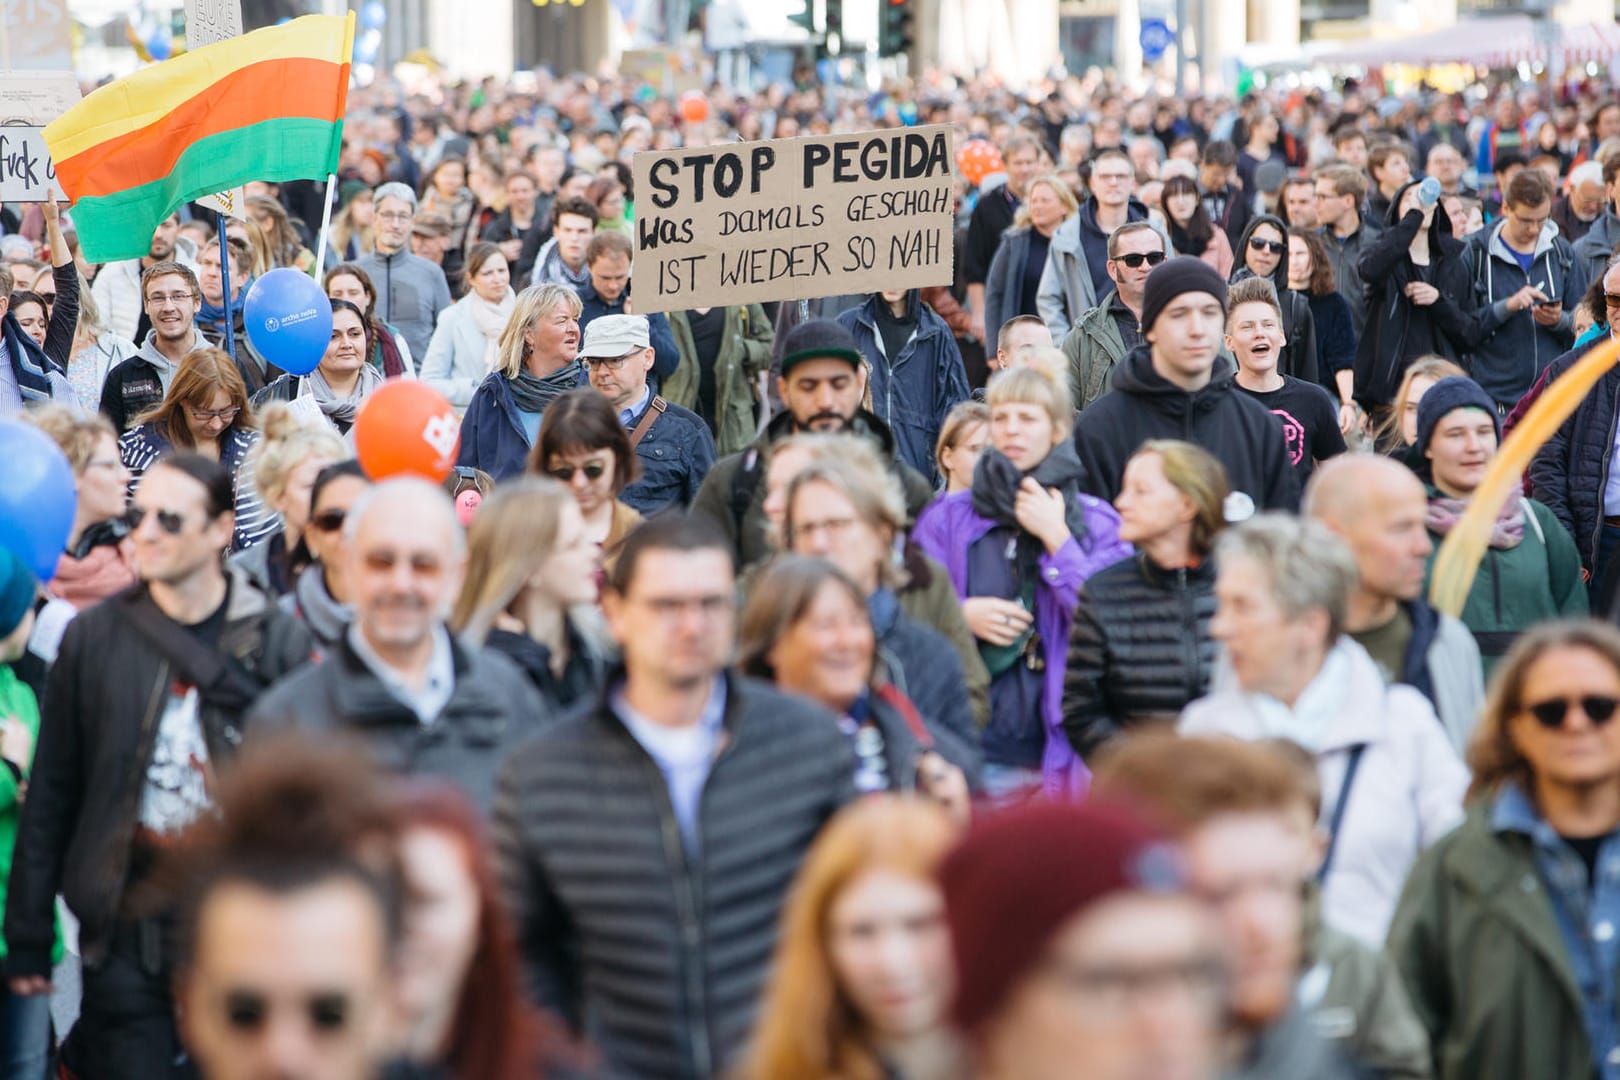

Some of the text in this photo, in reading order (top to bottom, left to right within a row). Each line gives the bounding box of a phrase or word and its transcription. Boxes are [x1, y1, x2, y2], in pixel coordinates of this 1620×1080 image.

[649, 133, 950, 209] STOP PEGIDA
[658, 229, 940, 296] IST WIEDER SO NAH
